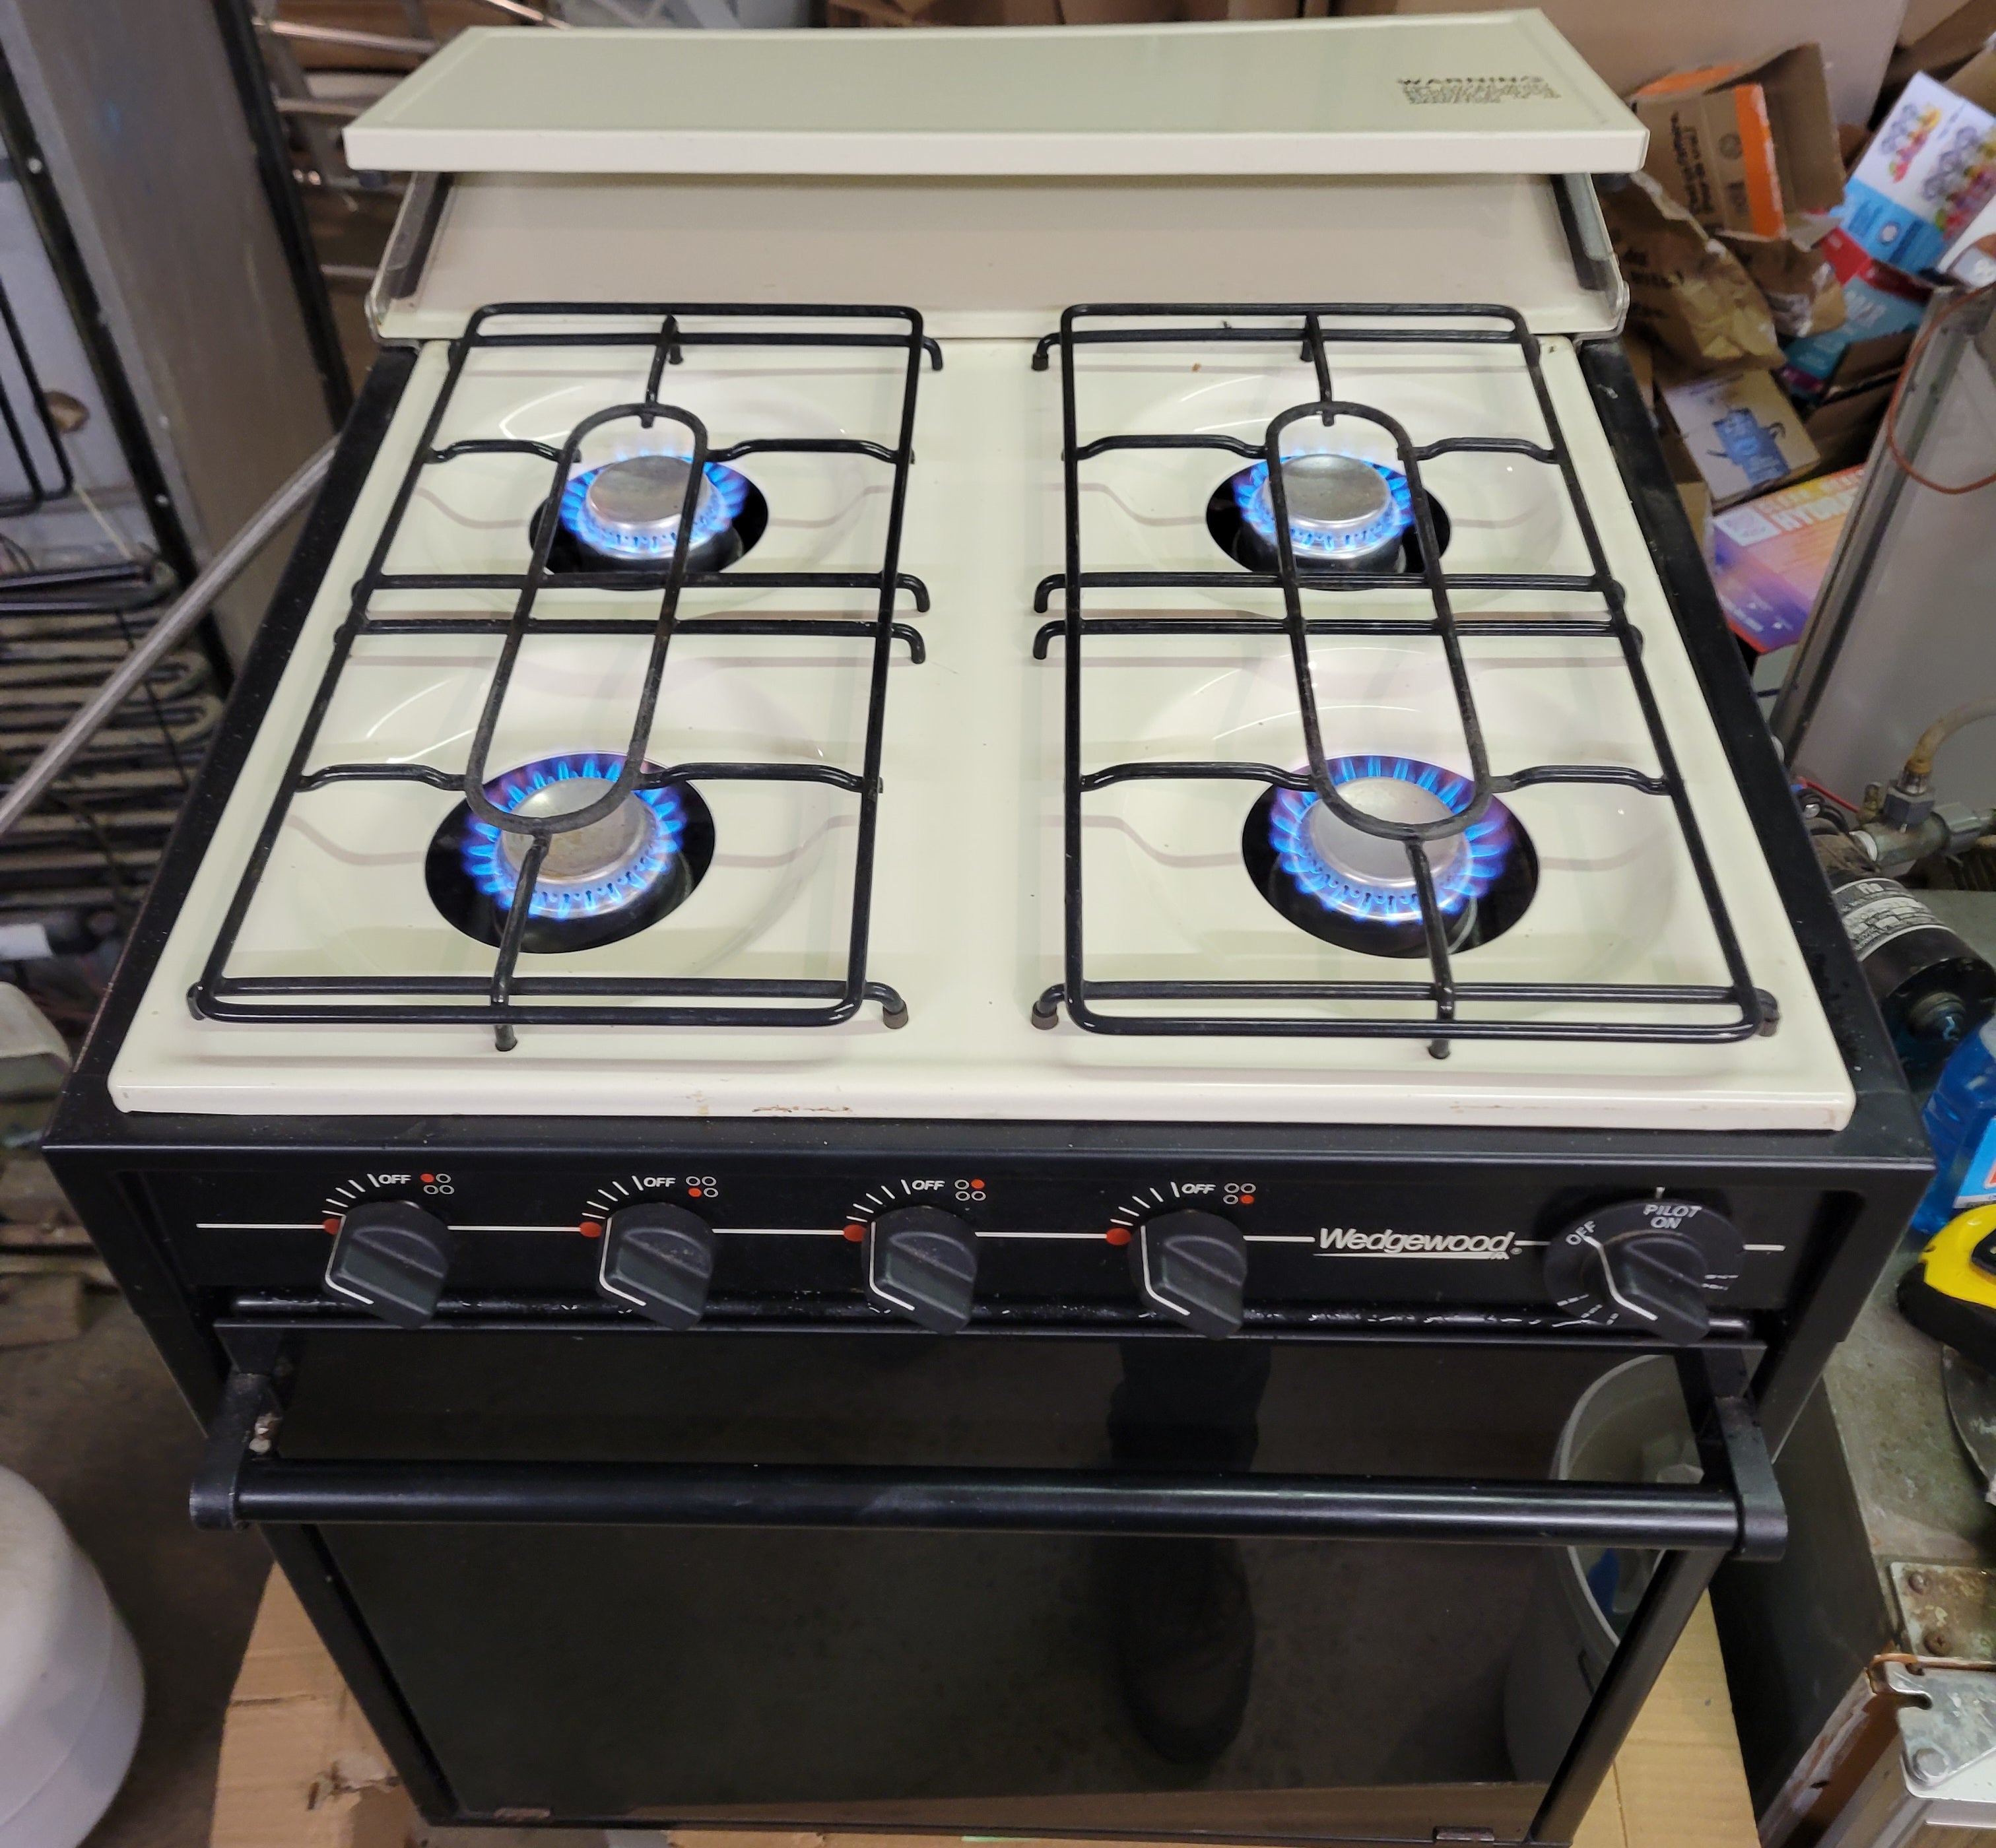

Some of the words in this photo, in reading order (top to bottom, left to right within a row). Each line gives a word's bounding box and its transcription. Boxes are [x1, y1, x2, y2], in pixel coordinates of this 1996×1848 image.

[378, 1174, 412, 1185] OFF
[643, 1177, 677, 1187] OFF
[912, 1179, 945, 1191] OFF
[1181, 1183, 1216, 1194] OFF
[1643, 1204, 1702, 1218] PILOT
[1650, 1216, 1682, 1229] ON
[1565, 1220, 1596, 1245] OFF
